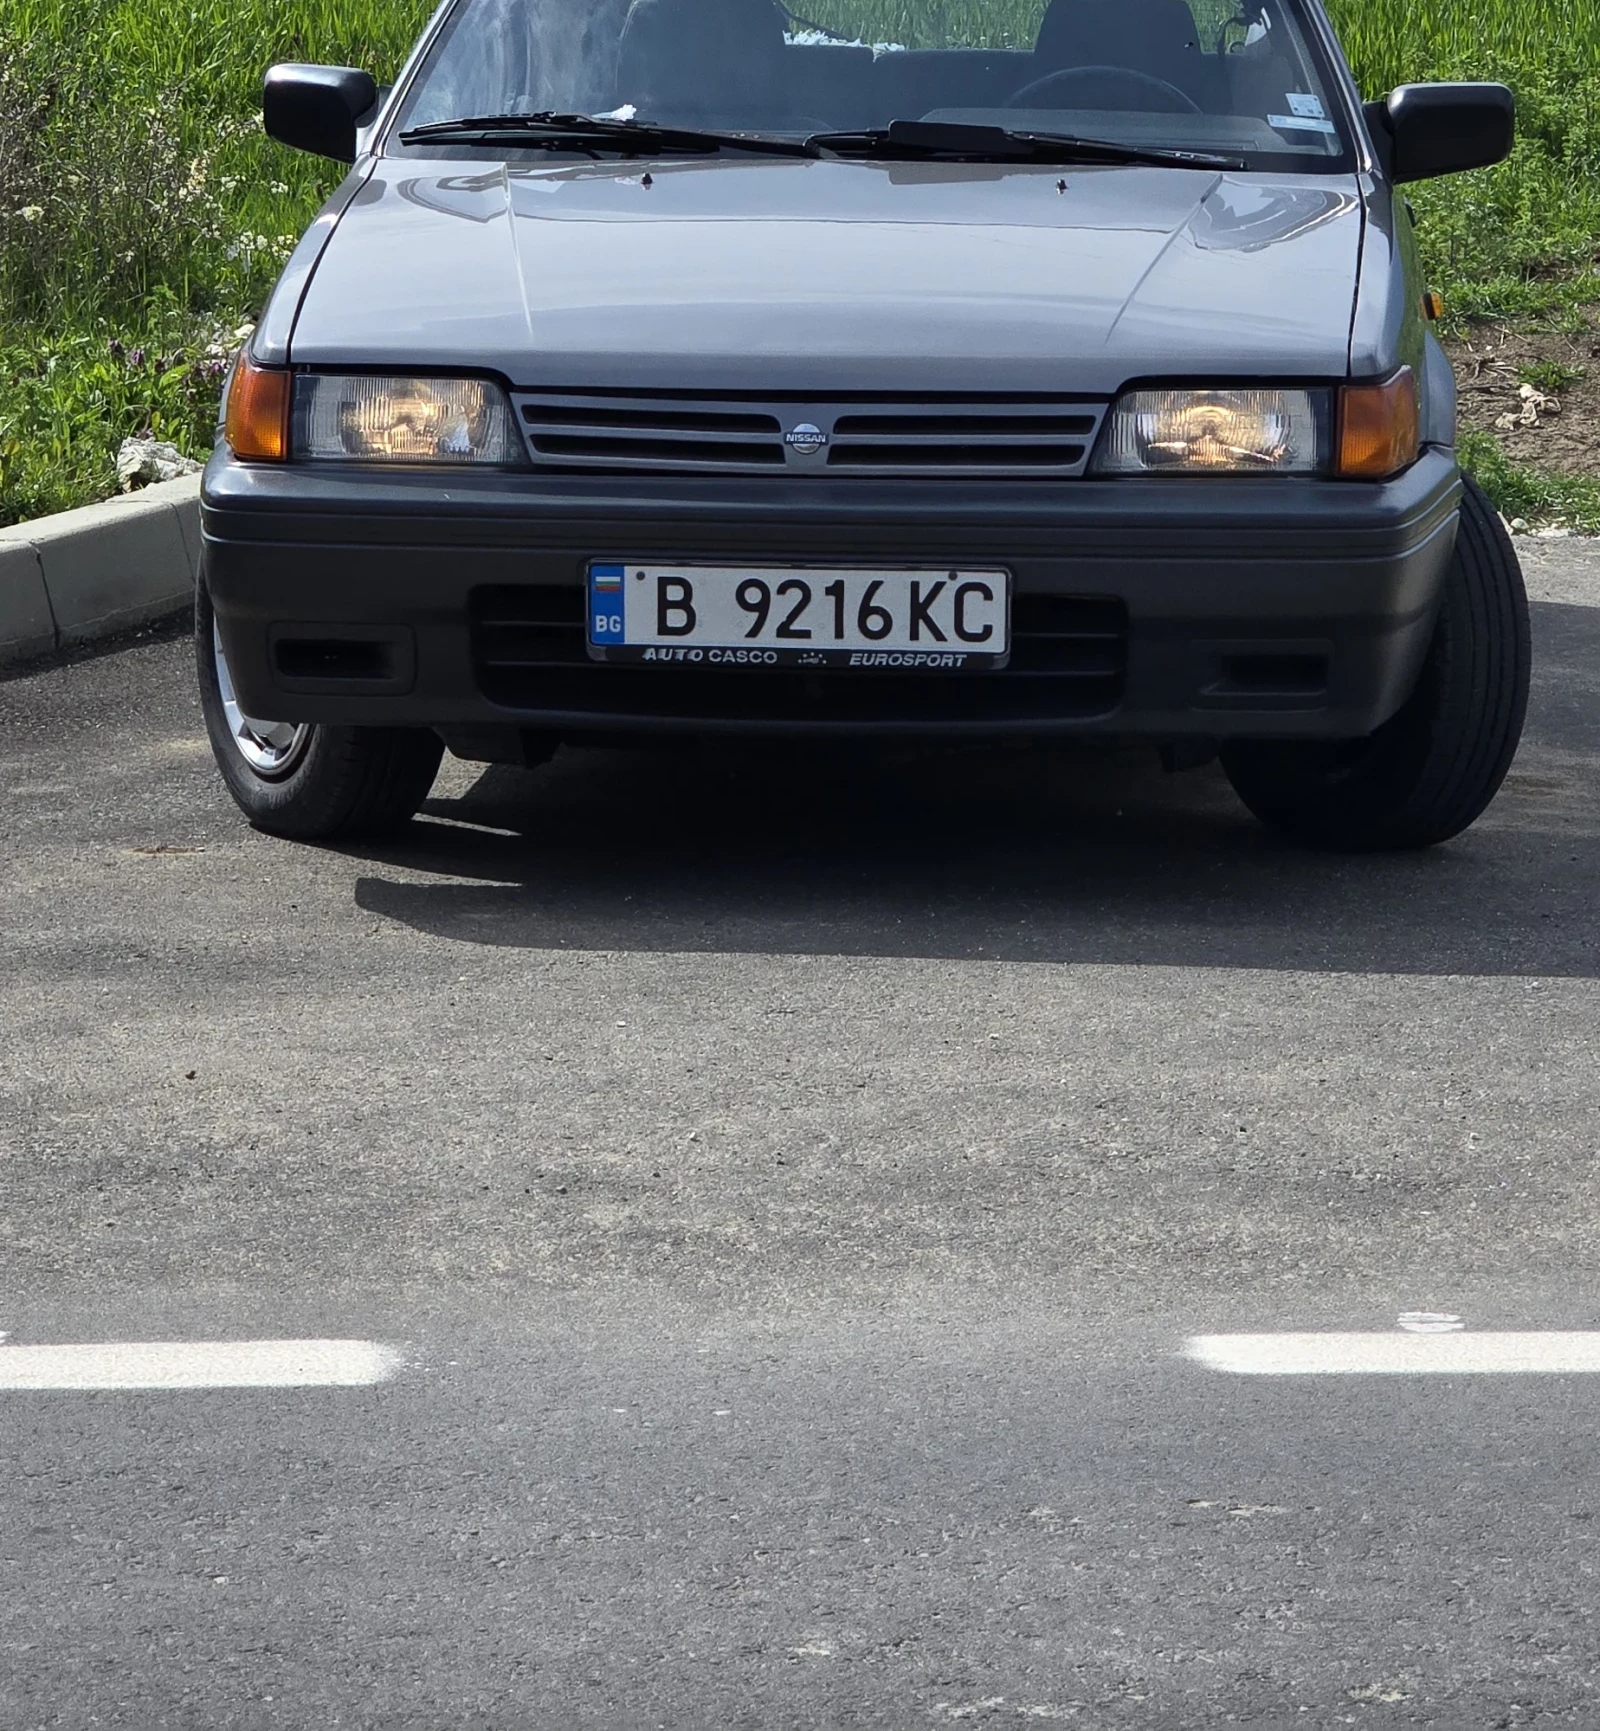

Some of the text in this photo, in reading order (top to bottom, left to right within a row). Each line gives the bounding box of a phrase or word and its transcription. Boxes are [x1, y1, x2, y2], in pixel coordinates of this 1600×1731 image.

[786, 433, 826, 443] NISSAN
[656, 576, 697, 636] B
[595, 615, 621, 633] BG
[641, 647, 968, 668] AUTO CASCO EUROSPORT
